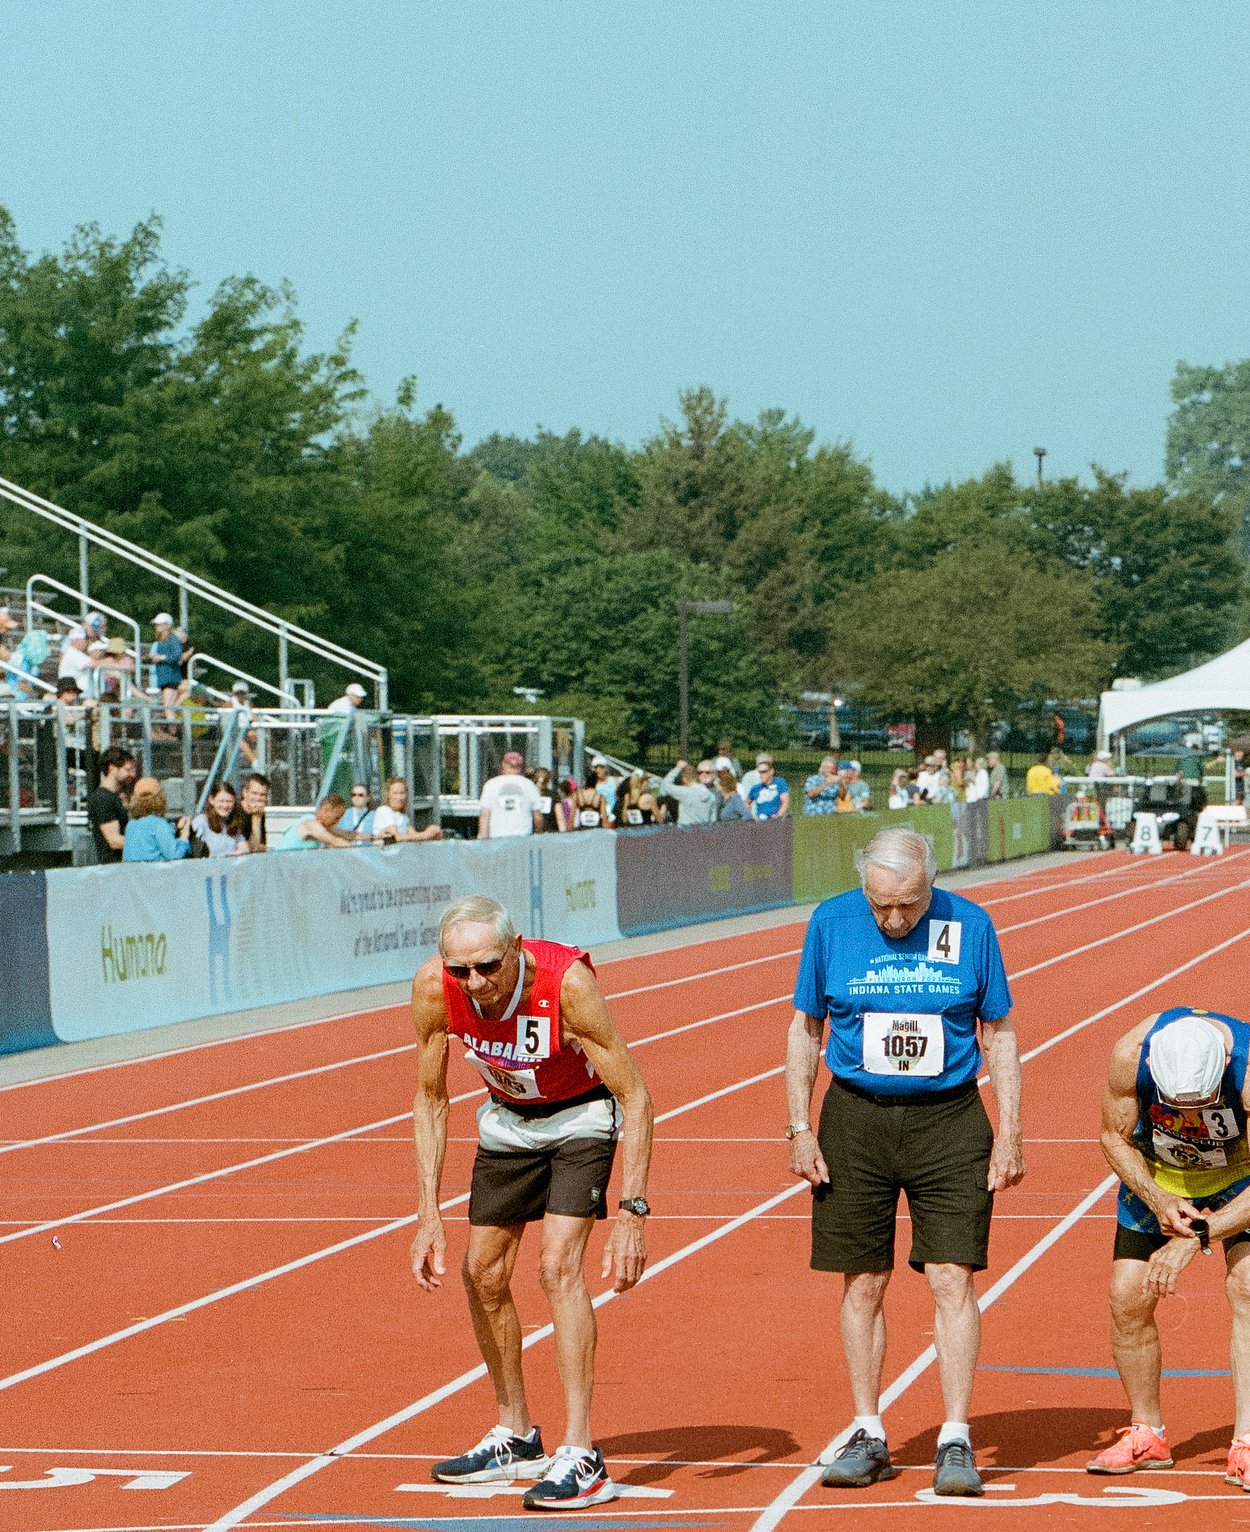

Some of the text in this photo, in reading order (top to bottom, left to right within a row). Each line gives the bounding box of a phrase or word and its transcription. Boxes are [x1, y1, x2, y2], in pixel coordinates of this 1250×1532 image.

[1141, 826, 1151, 841] 8
[1202, 827, 1213, 841] 7
[936, 924, 951, 958] 4
[102, 925, 168, 984] Humana
[849, 984, 960, 995] INDIANA STATE GAMES
[892, 1020, 918, 1032] Magill
[525, 1020, 539, 1054] 5
[881, 1035, 928, 1058] 1057
[898, 1060, 909, 1071] IN
[1210, 1112, 1229, 1138] 3
